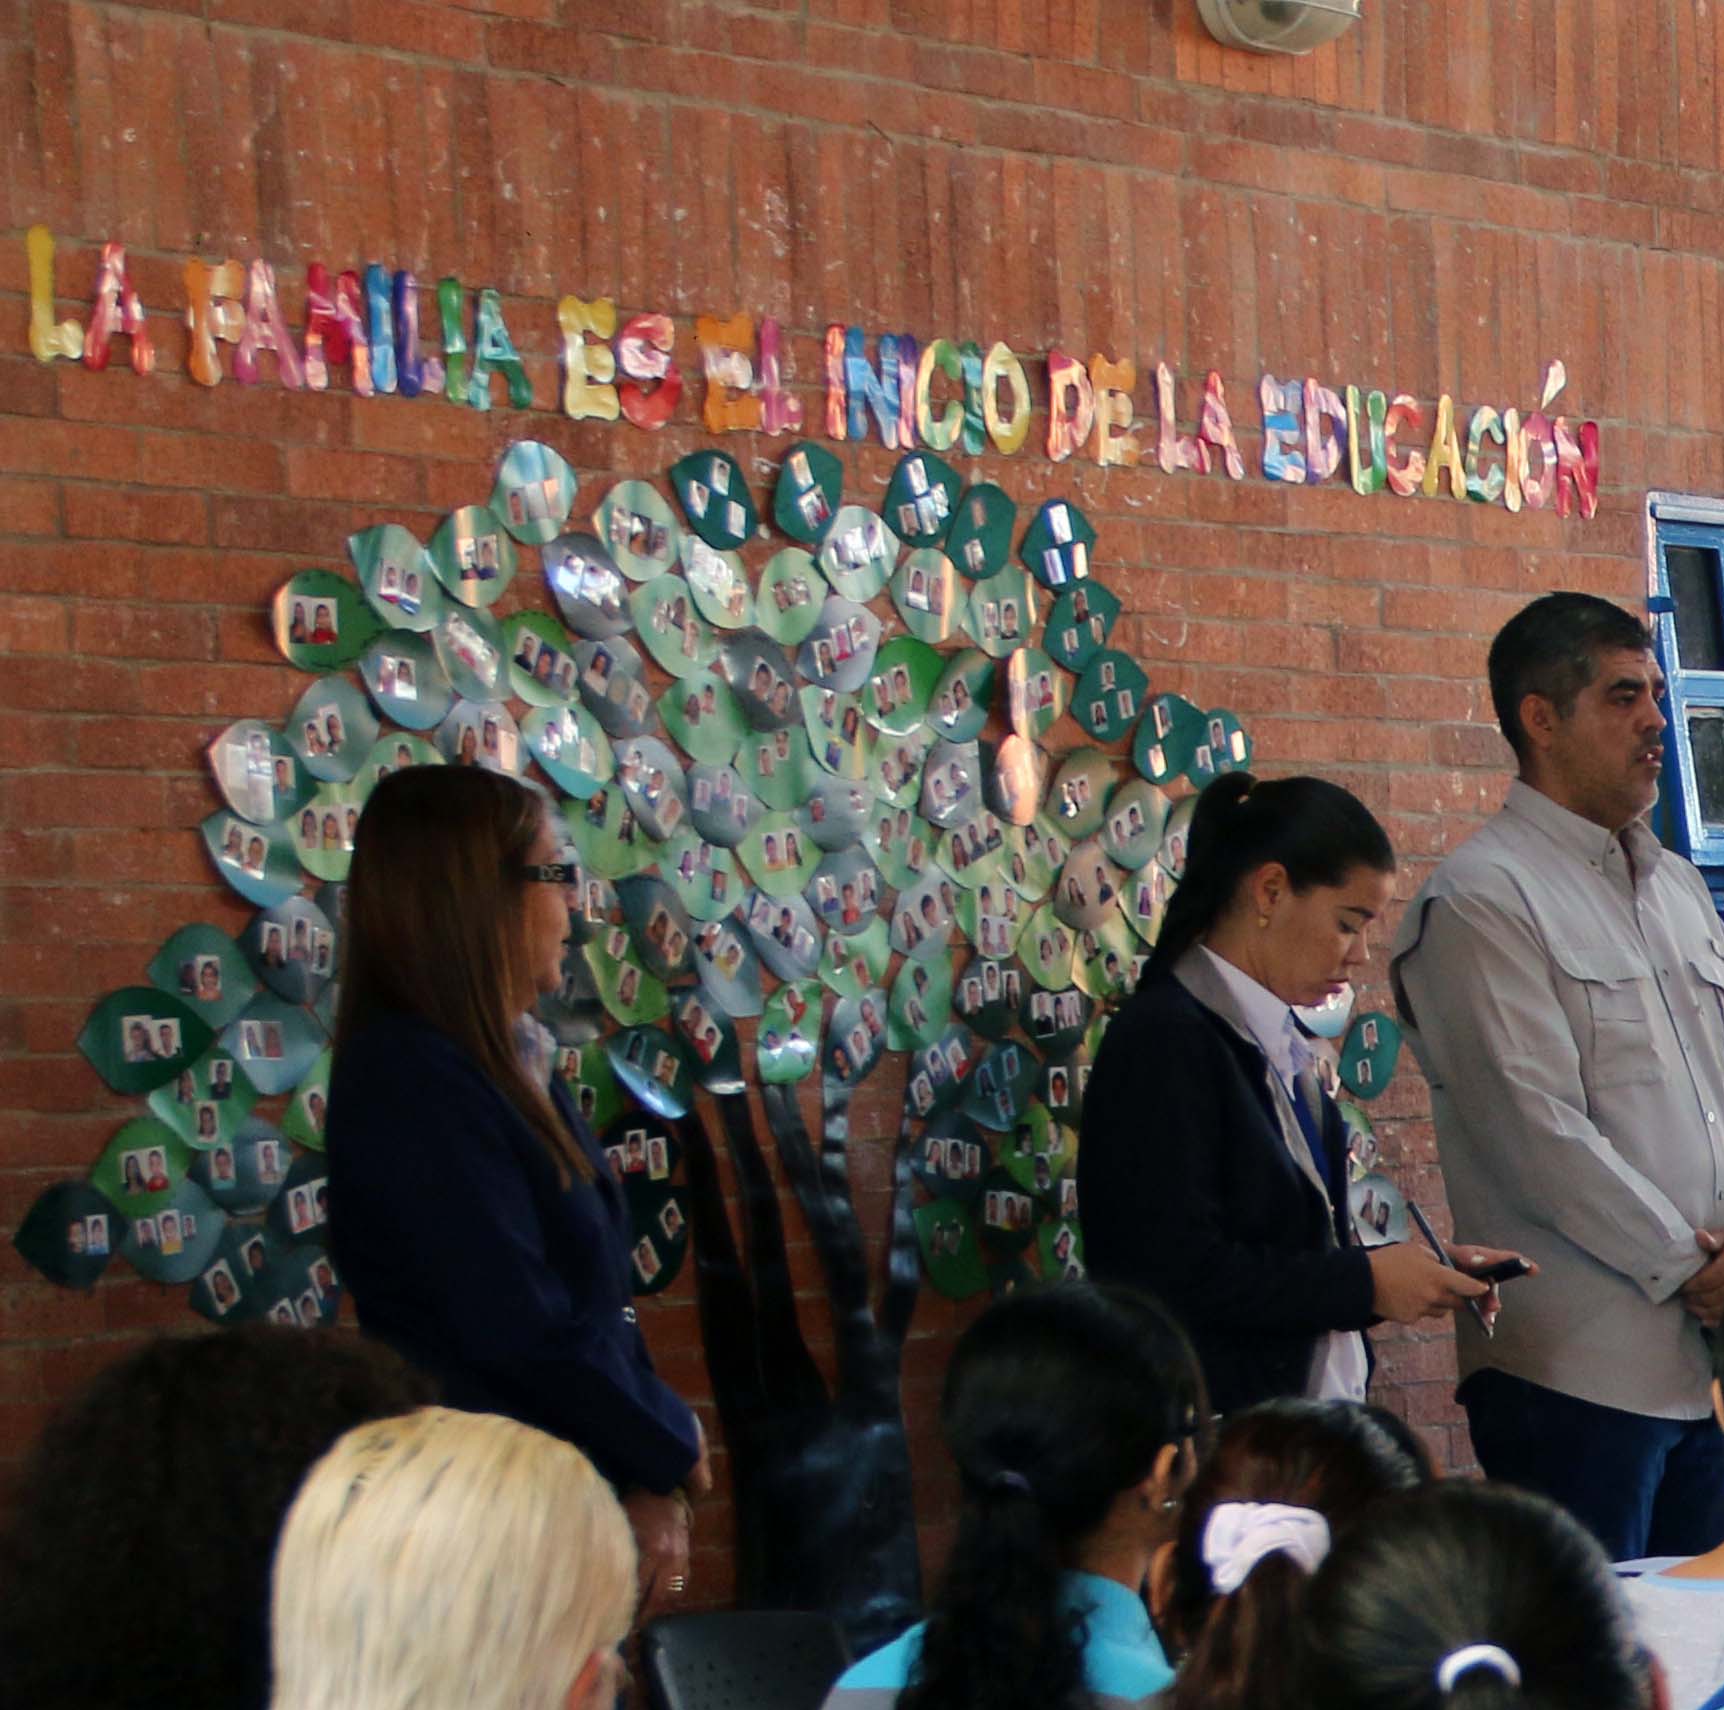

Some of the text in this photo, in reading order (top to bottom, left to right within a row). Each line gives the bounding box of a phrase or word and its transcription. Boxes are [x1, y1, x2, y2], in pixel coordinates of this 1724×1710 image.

[26, 224, 1600, 519] LA FAMILIA ES EL INICIO DE LA EDUCACIÓN
